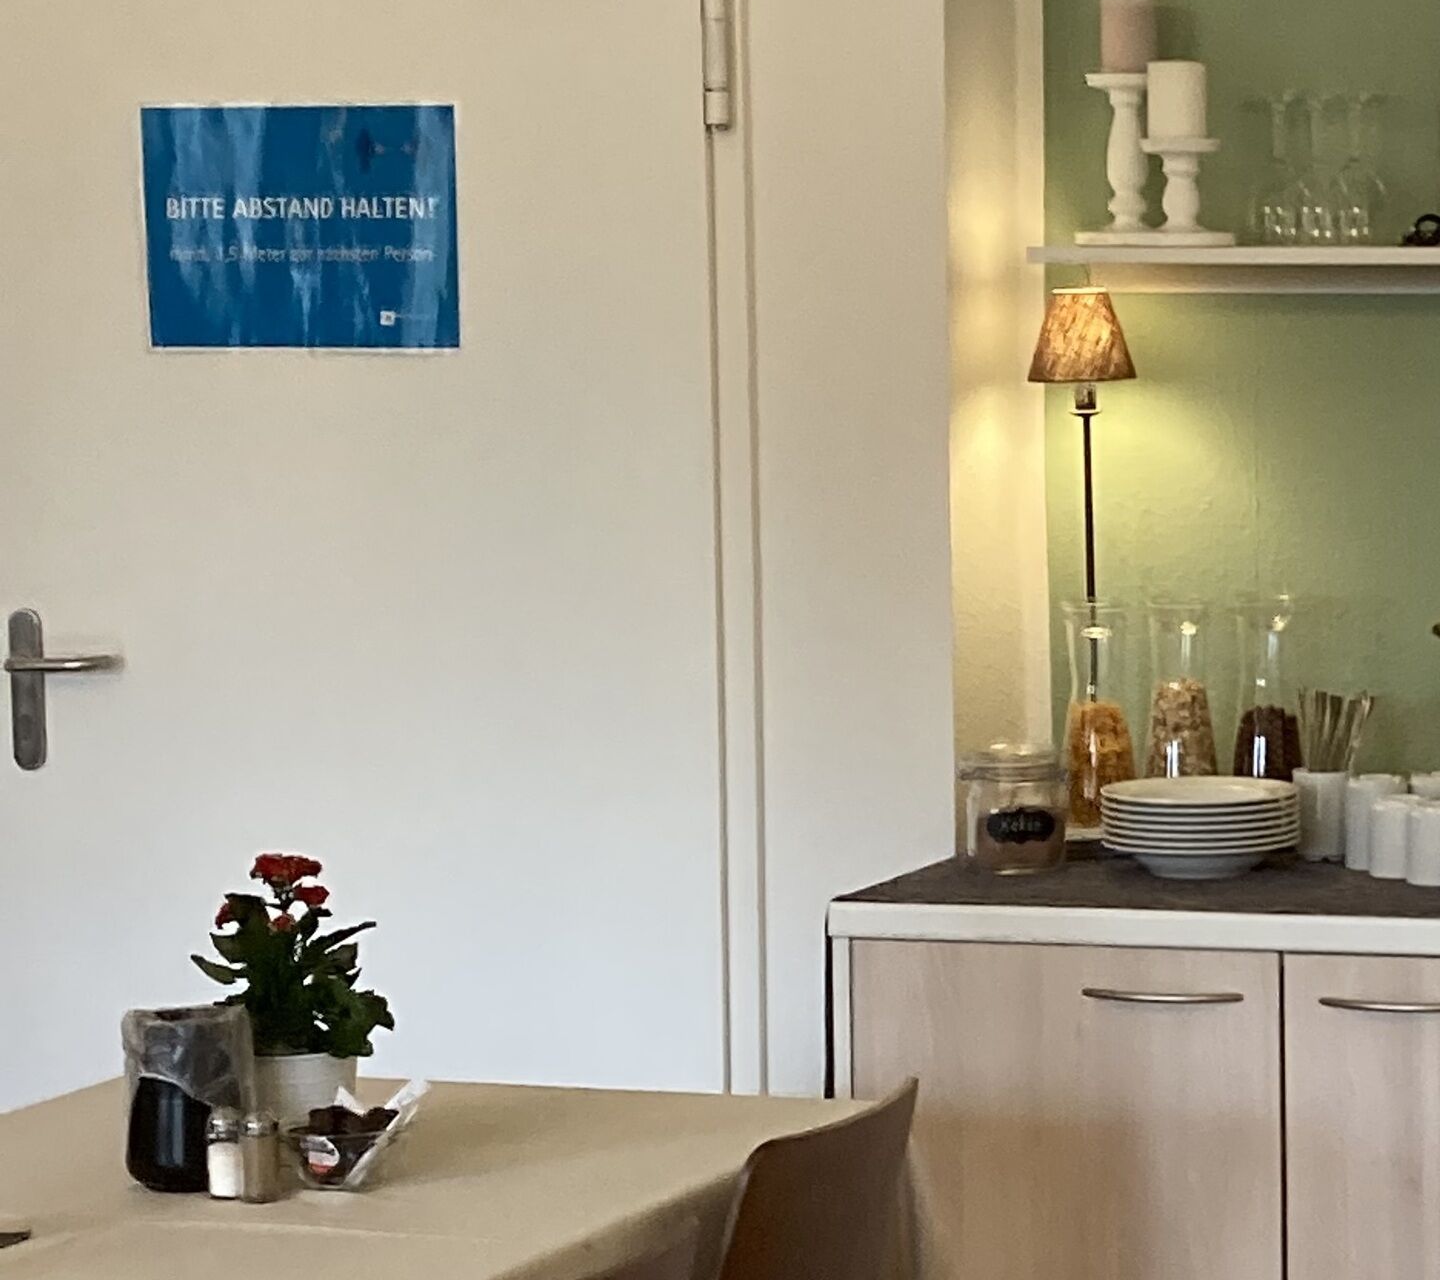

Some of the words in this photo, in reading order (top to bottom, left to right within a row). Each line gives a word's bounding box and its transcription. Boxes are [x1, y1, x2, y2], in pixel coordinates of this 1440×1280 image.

[166, 196, 225, 219] BITTE
[232, 196, 334, 219] ABSTAND
[340, 196, 437, 219] HALTEN!
